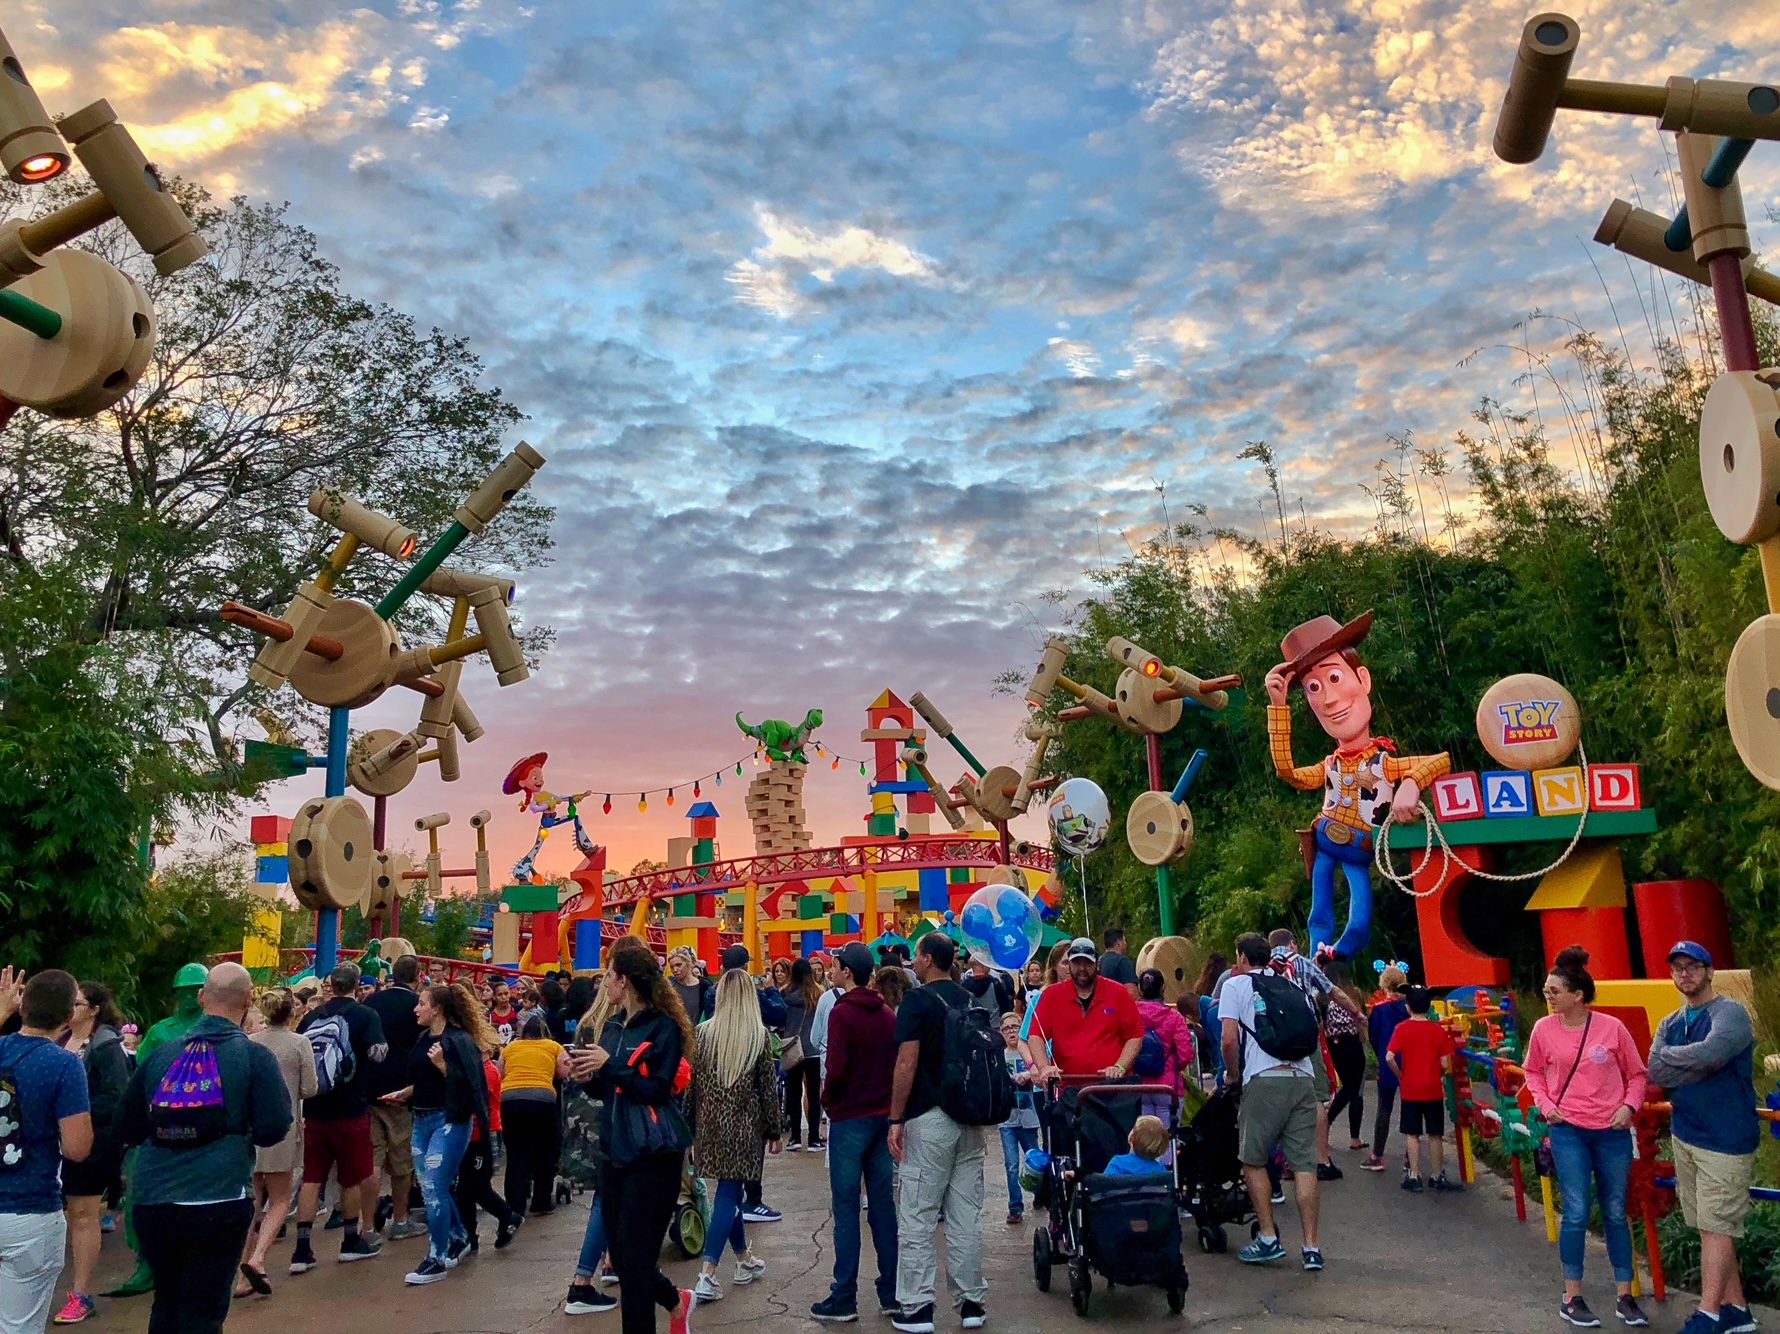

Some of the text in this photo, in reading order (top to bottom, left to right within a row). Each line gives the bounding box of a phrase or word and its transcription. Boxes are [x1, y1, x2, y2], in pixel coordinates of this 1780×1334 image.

[1499, 702, 1559, 729] TOY
[1508, 728, 1553, 739] STORY
[1442, 773, 1631, 811] LAND
